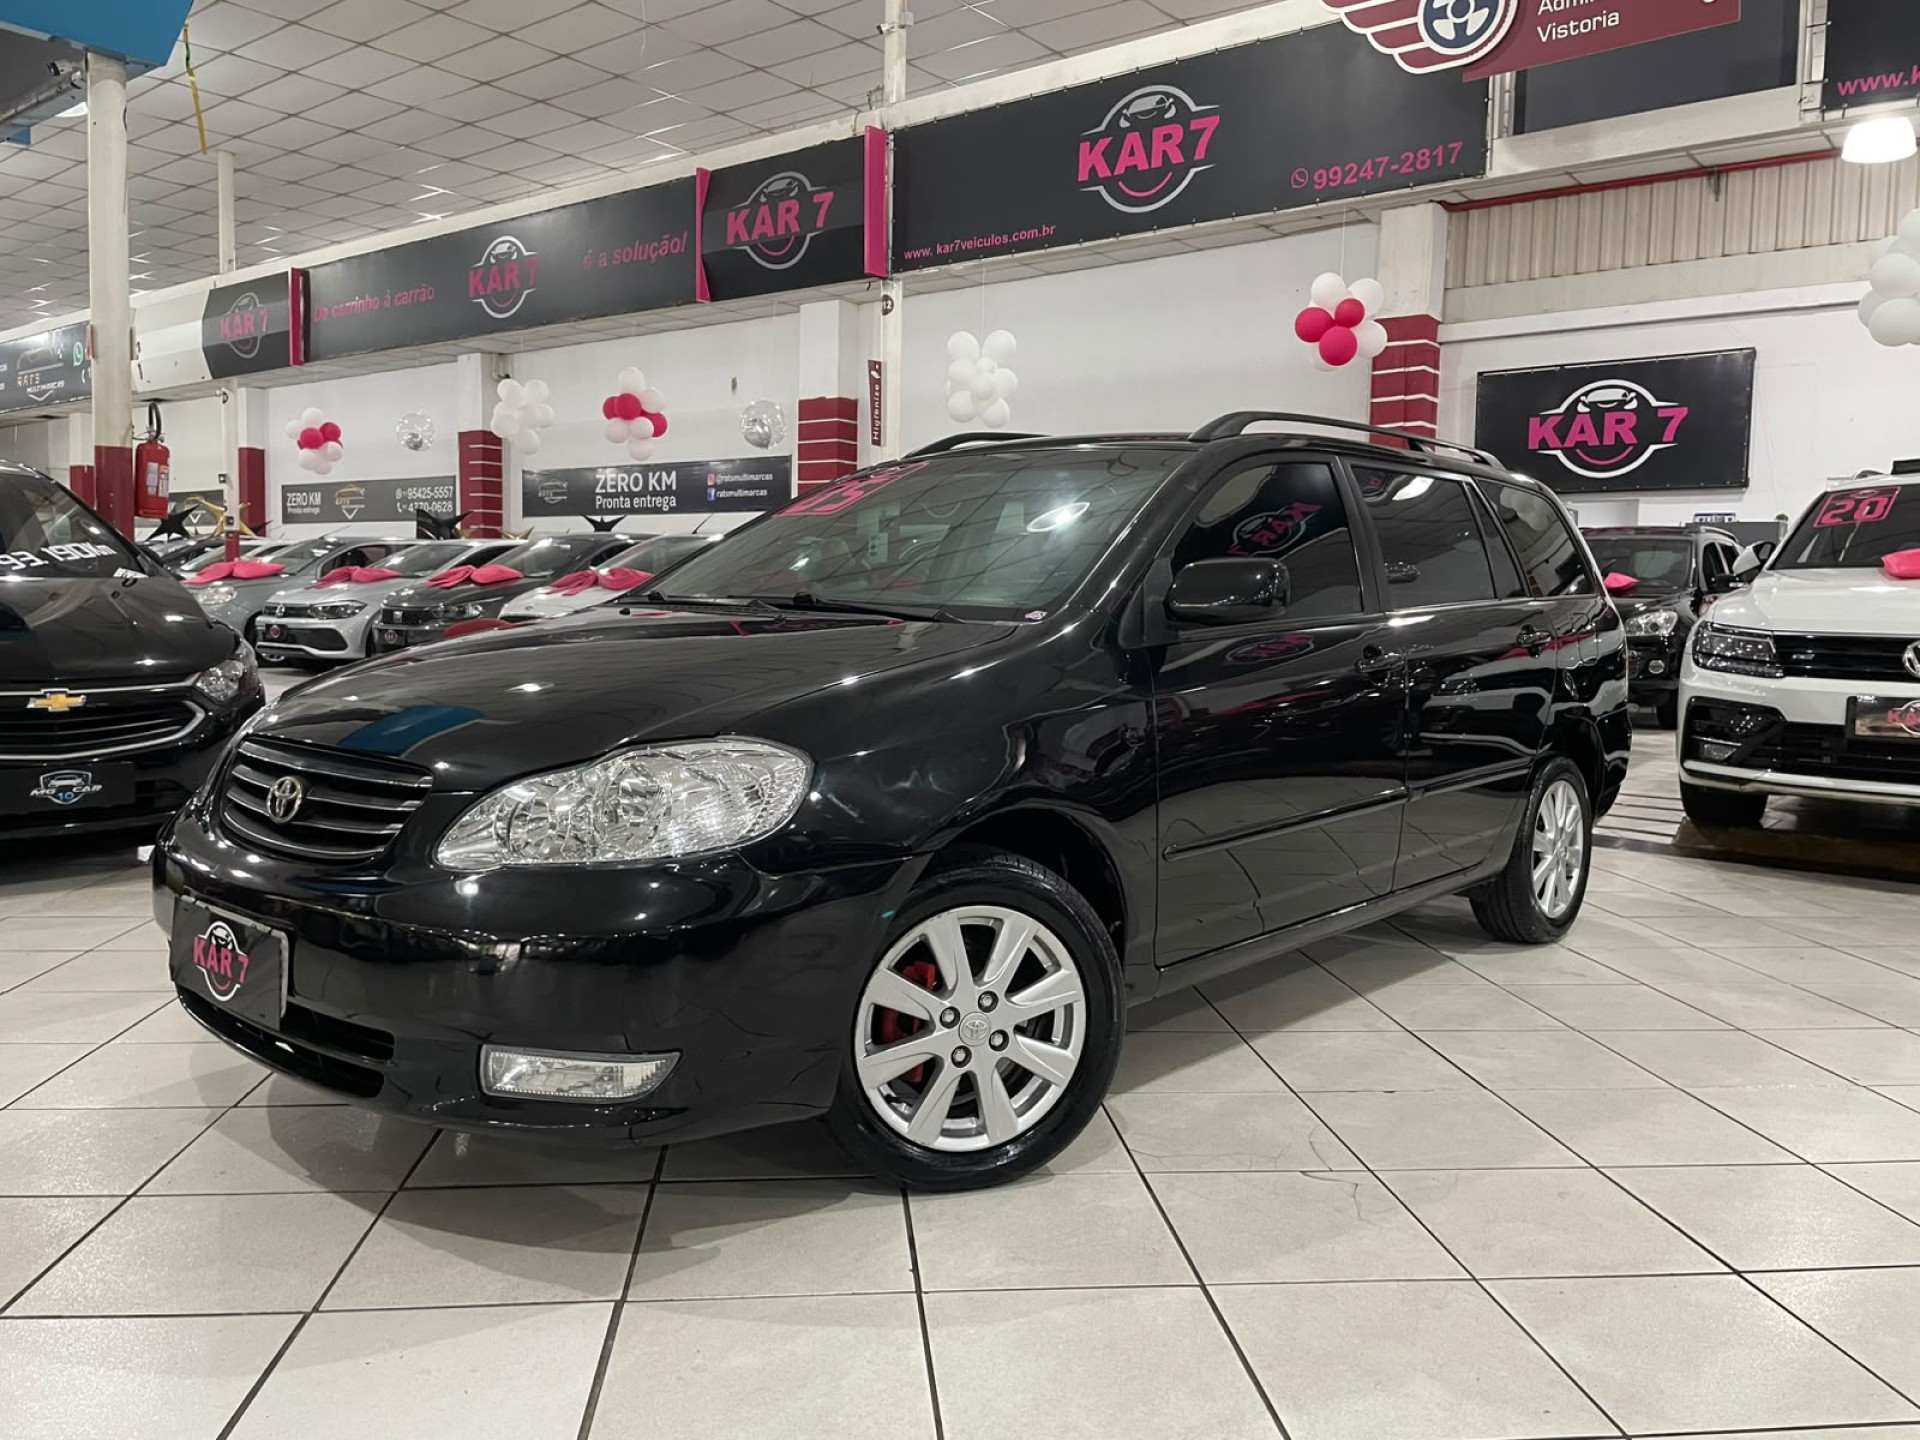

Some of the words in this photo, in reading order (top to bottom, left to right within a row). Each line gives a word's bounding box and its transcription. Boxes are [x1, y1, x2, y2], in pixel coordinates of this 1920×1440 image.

[1536, 10, 1620, 43] Vistoria
[1078, 123, 1185, 182] KAR
[1189, 115, 1220, 161] 7
[1313, 141, 1463, 191] 99247-2817
[726, 199, 800, 246] KAR
[812, 191, 834, 229] 7
[598, 254, 608, 268] a
[612, 231, 689, 264] solução!
[468, 261, 521, 298] KAR
[526, 257, 539, 287] 7
[332, 293, 379, 318] carrinho
[394, 283, 435, 306] carrão
[220, 310, 255, 340] KAR
[259, 308, 269, 333] 7
[873, 384, 881, 440] Higienize
[1528, 411, 1638, 450] KAR
[1657, 407, 1689, 442] 7
[286, 492, 308, 506] ZERO
[309, 491, 321, 505] KM
[595, 472, 643, 493] ZERO
[648, 470, 677, 492] KM
[595, 495, 631, 509] Pronta
[633, 494, 677, 511] entrega
[1821, 497, 1889, 523] 20
[58, 791, 74, 800] 10
[72, 785, 102, 793] CAR
[193, 936, 233, 978] KAR
[238, 955, 249, 984] 7
